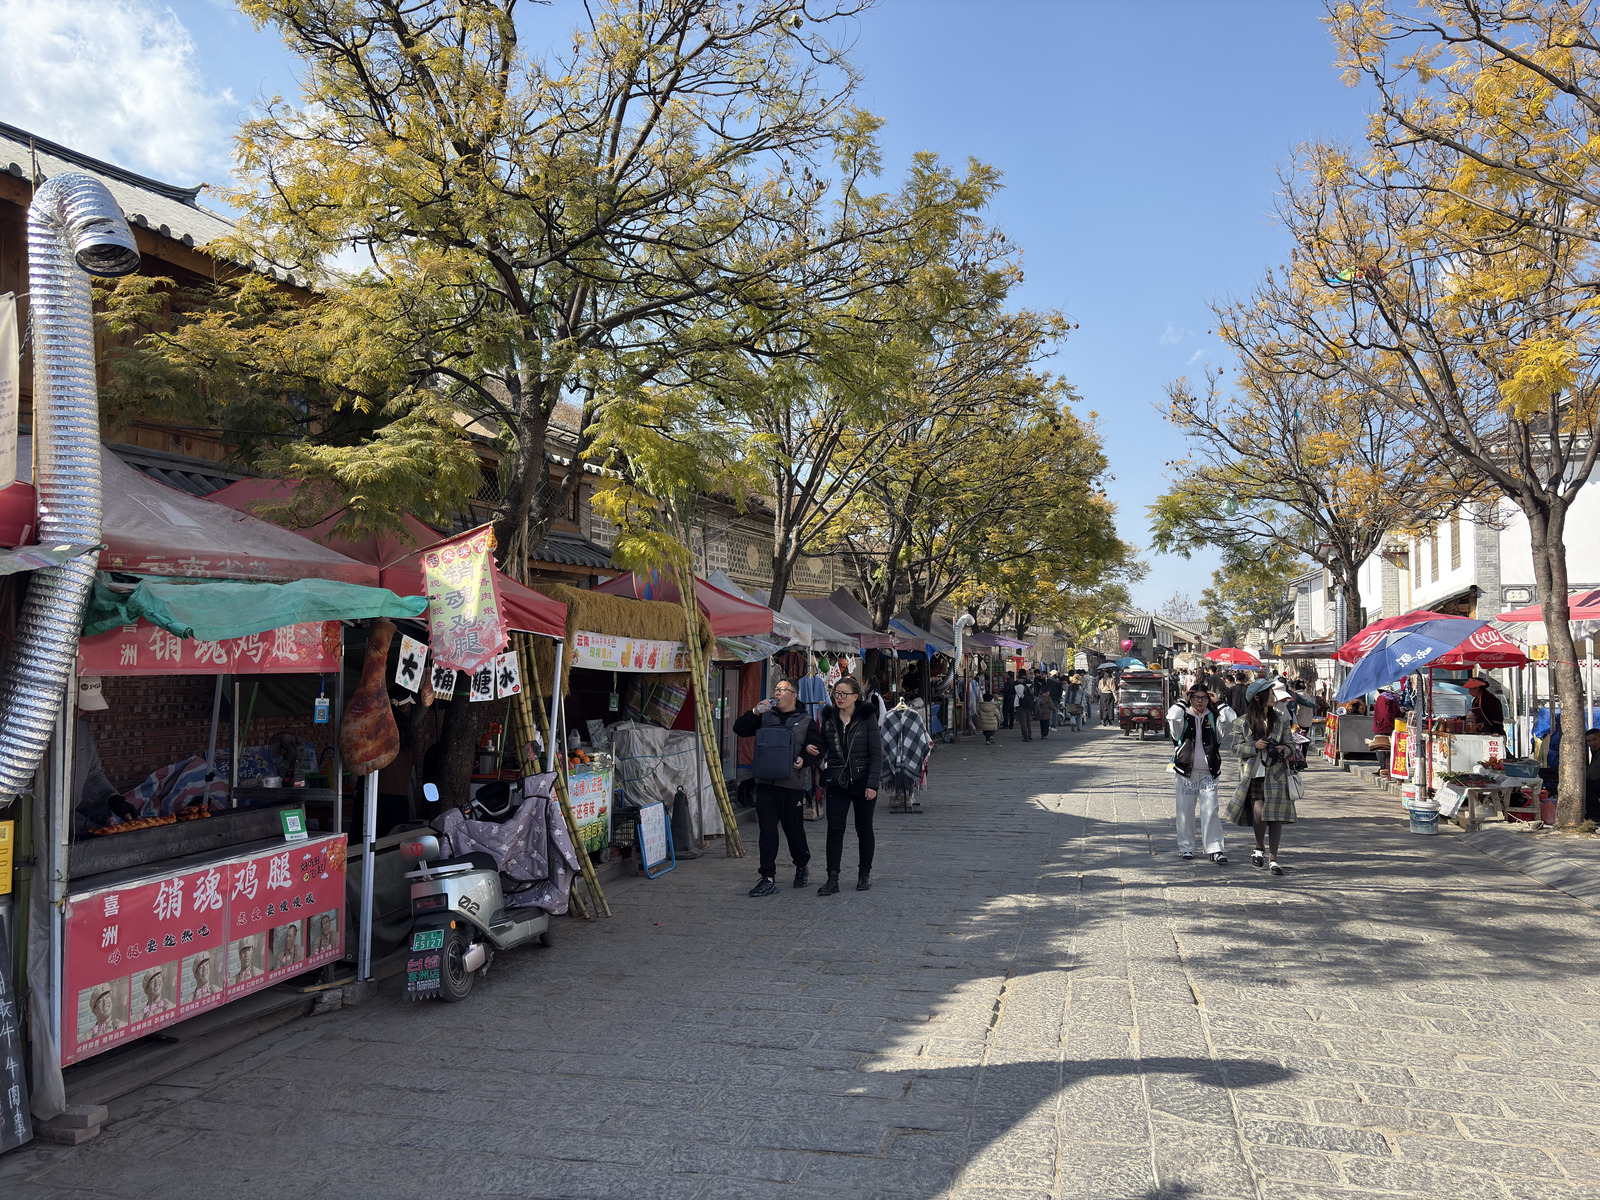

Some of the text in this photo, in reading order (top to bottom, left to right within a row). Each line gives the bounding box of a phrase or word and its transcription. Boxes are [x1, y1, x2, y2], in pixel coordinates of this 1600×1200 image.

[441, 560, 486, 660] 销魂鸡腿
[150, 625, 300, 664] 销魂鸡腿
[573, 776, 603, 797] 比情人还甜
[153, 851, 293, 921] 销魂鸡腿
[458, 894, 480, 916] 02
[101, 894, 120, 948] 喜洲
[415, 938, 442, 950] F5127
